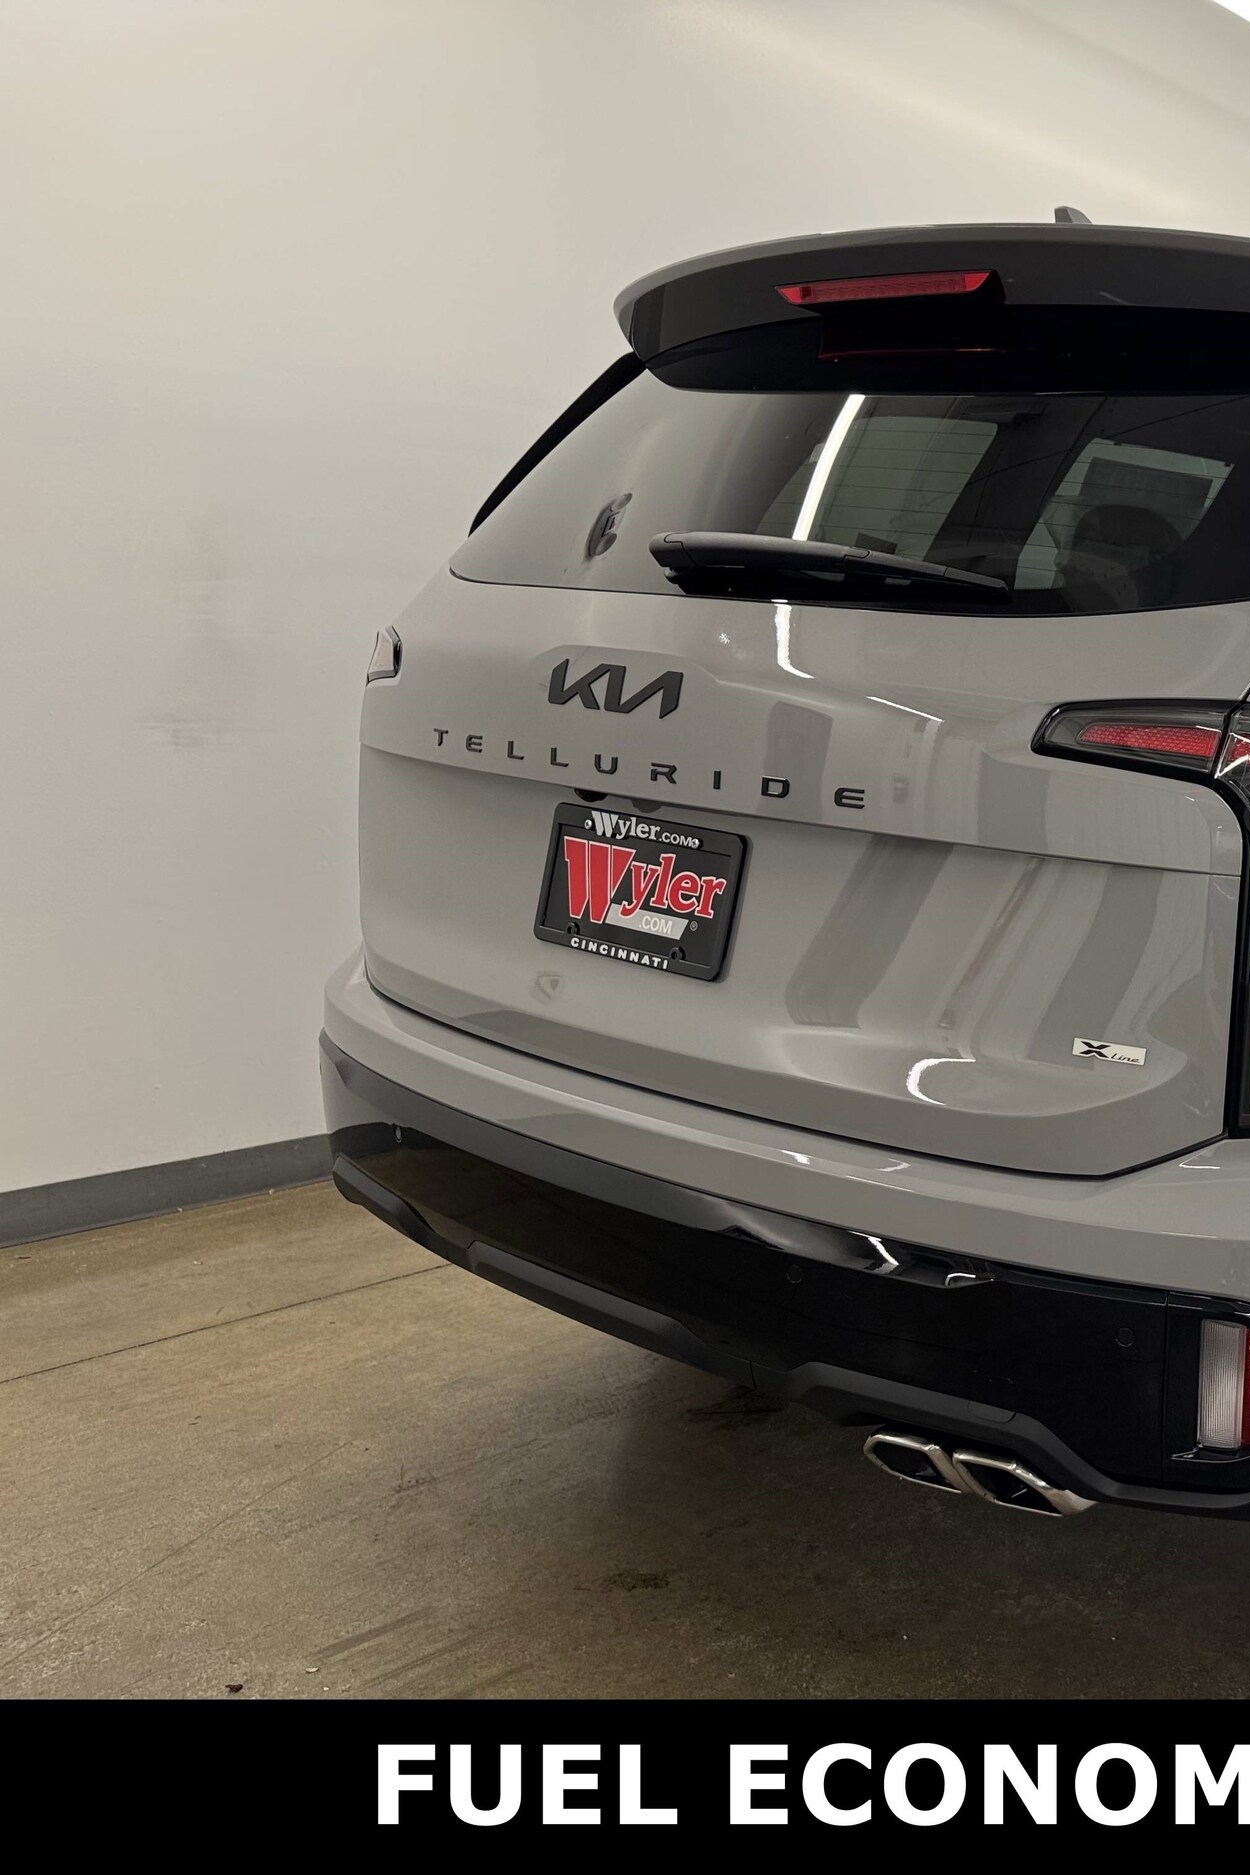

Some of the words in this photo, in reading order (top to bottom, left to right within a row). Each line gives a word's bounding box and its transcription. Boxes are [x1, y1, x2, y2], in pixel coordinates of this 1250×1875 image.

[547, 658, 684, 720] KIA
[433, 727, 866, 810] TELLURIDE
[563, 835, 727, 924] Wyler
[570, 937, 670, 970] CINCINNATI
[638, 915, 674, 935] .COM
